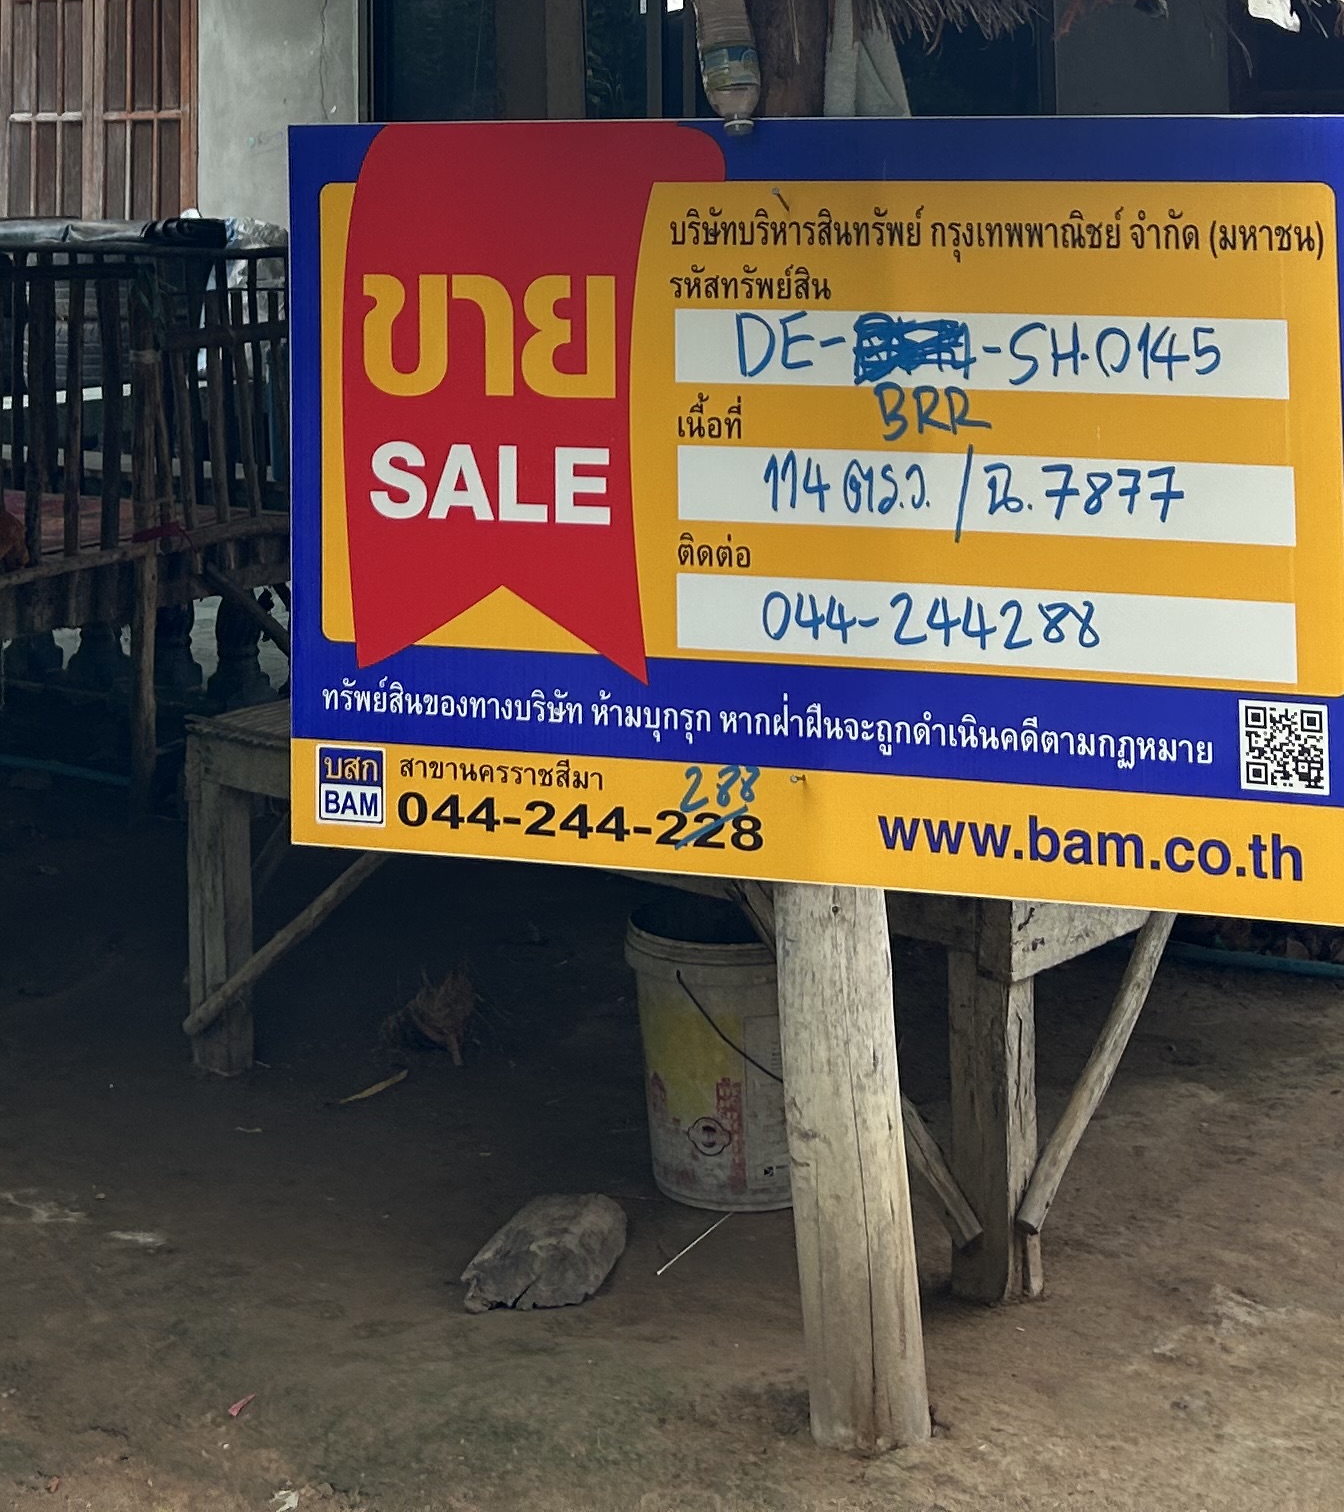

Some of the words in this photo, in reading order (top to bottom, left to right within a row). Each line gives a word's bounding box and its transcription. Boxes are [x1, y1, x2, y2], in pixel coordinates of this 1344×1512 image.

[670, 204, 925, 248] บริษัทบริหารสินทรัพย์
[930, 206, 1123, 263] กรุงเทพพาณิชย์
[1129, 208, 1201, 251] จำกัด
[1209, 219, 1325, 262] (มหาชน)
[669, 265, 832, 301] รหัสทรัพย์สิน
[362, 273, 617, 400] ขาย
[677, 393, 743, 440] เนื้อที่
[874, 381, 992, 441] BRR
[369, 440, 612, 526] SALE
[677, 532, 751, 569] ติดต่อ
[762, 590, 1101, 650] 044-244288
[321, 675, 584, 725] ทรัพย์สินของทางบริษัท
[591, 691, 712, 745] ห้ามบุกรุก
[324, 756, 379, 783] บสก
[399, 758, 605, 792] สาขานครราชสีมา
[324, 789, 379, 818] BAM
[876, 814, 1304, 882] www.bam.co.th
